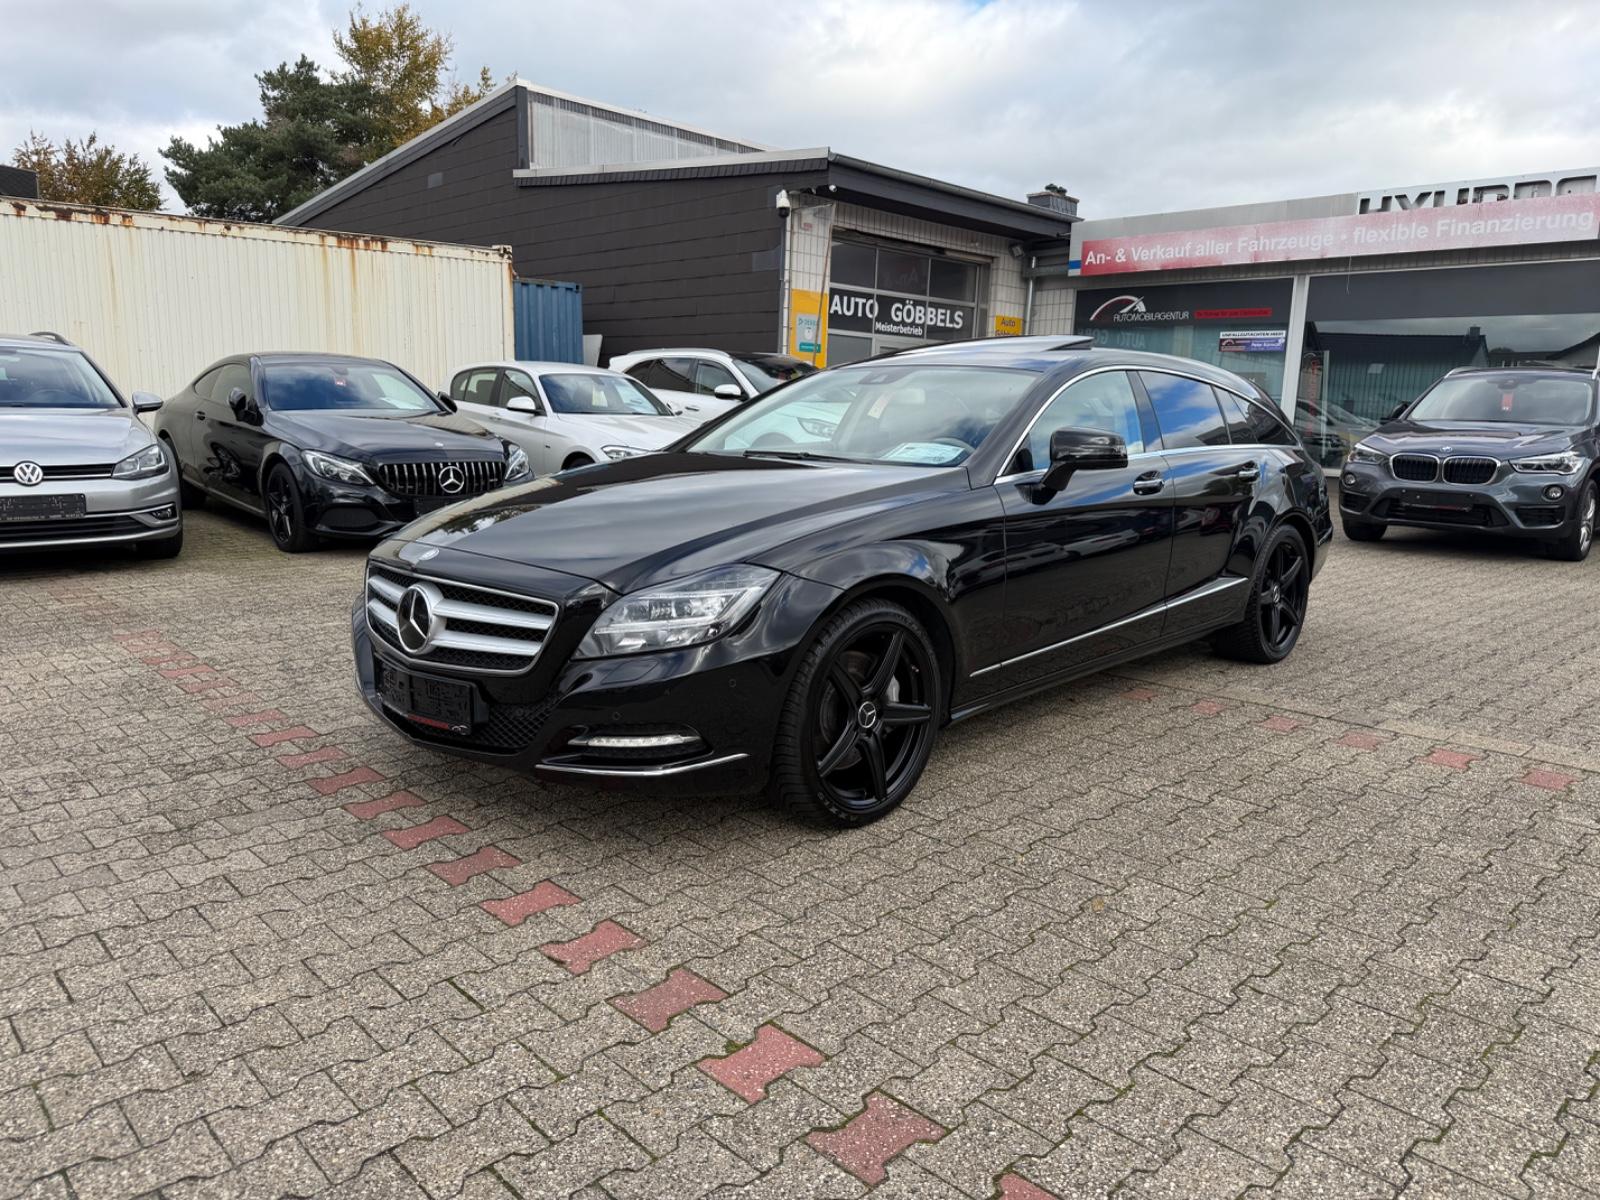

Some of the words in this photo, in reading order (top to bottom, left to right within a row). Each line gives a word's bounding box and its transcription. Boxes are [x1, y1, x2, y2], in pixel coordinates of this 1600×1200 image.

[1085, 250, 1112, 265] An-
[1115, 248, 1126, 263] &
[1131, 243, 1191, 261] Verkauf
[1195, 240, 1231, 257] aller
[1237, 231, 1334, 253] Fahrzeuge
[1353, 222, 1429, 244] flexible
[1435, 211, 1595, 238] Finanzierung
[829, 294, 879, 319] AUTO
[890, 299, 963, 329] GÖBBELS
[874, 321, 923, 336] Meisterbetrieb
